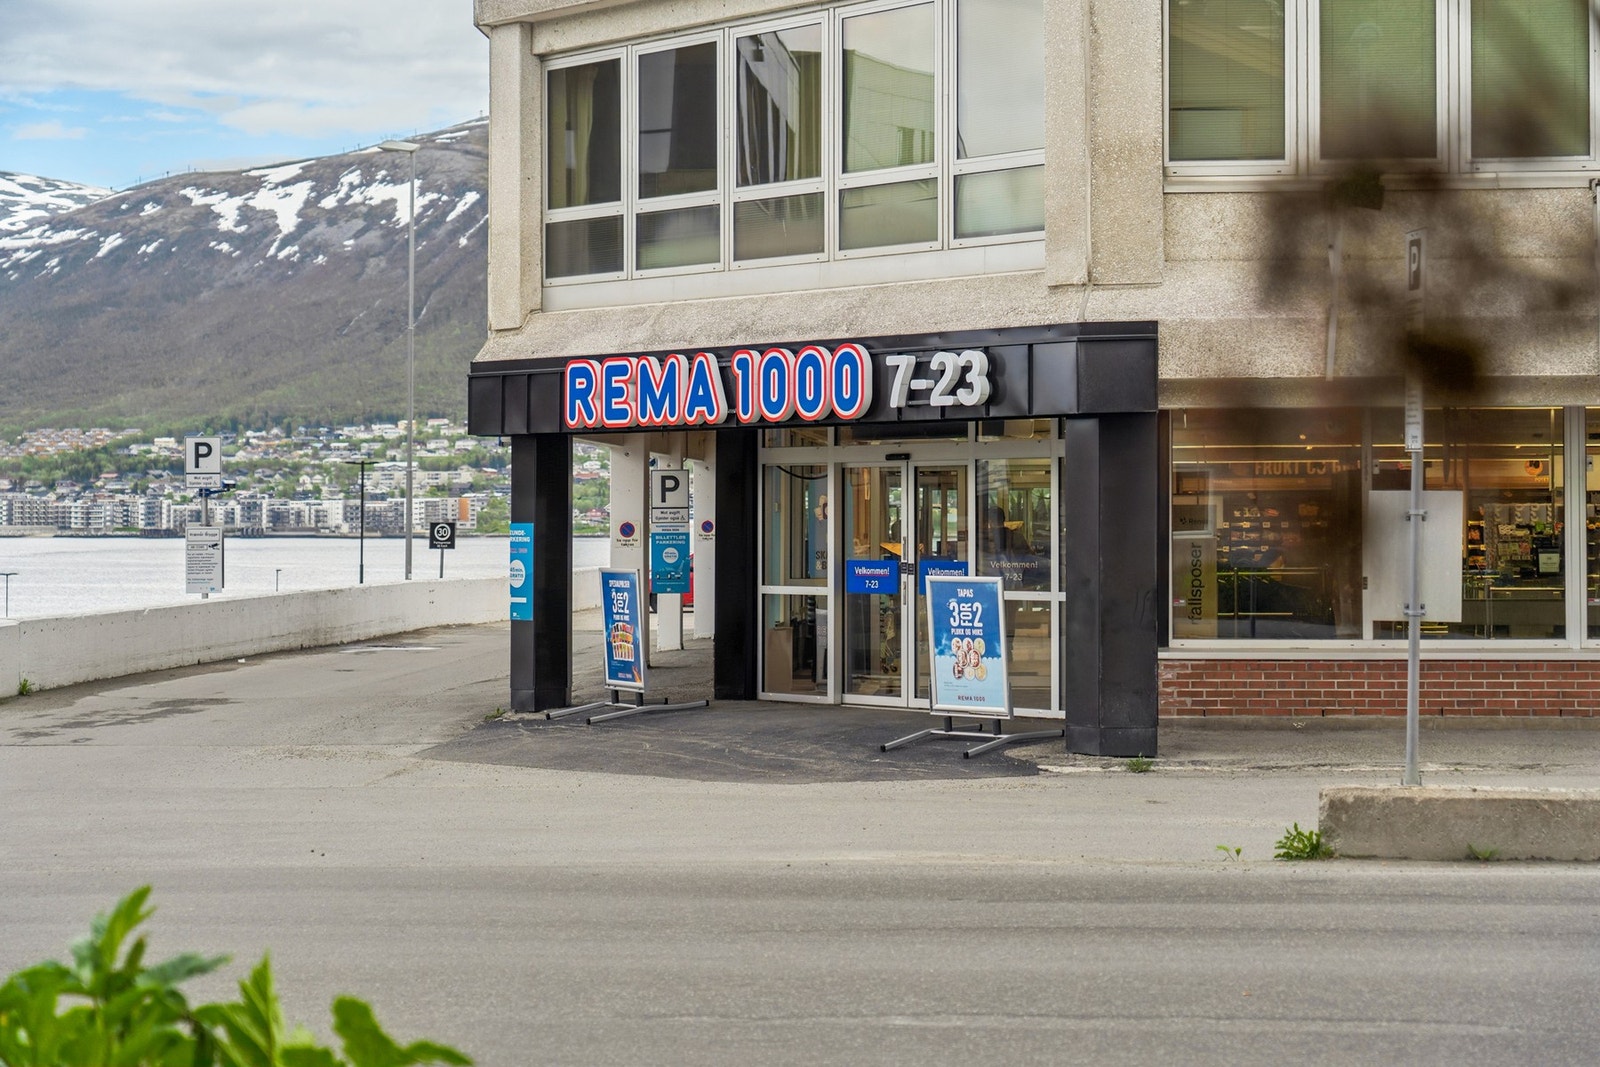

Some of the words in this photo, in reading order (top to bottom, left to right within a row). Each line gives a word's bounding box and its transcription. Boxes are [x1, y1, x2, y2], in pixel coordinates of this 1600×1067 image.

[1411, 246, 1418, 285] P
[565, 353, 728, 429] REMA
[731, 342, 873, 424] 1000
[886, 350, 990, 408] 7-23
[194, 442, 212, 468] P
[661, 475, 680, 503] P
[437, 528, 448, 536] 30
[854, 566, 890, 575] Velkommen!
[927, 567, 965, 576] Velkommen!
[1005, 573, 1023, 581] 7-23
[865, 580, 879, 589] 7-23
[957, 589, 974, 597] TAPAS
[611, 591, 618, 613] 3
[617, 592, 625, 613] FOR
[623, 592, 630, 614] 2
[949, 601, 960, 627] 3
[960, 602, 972, 627] FOR
[973, 602, 983, 628] 2
